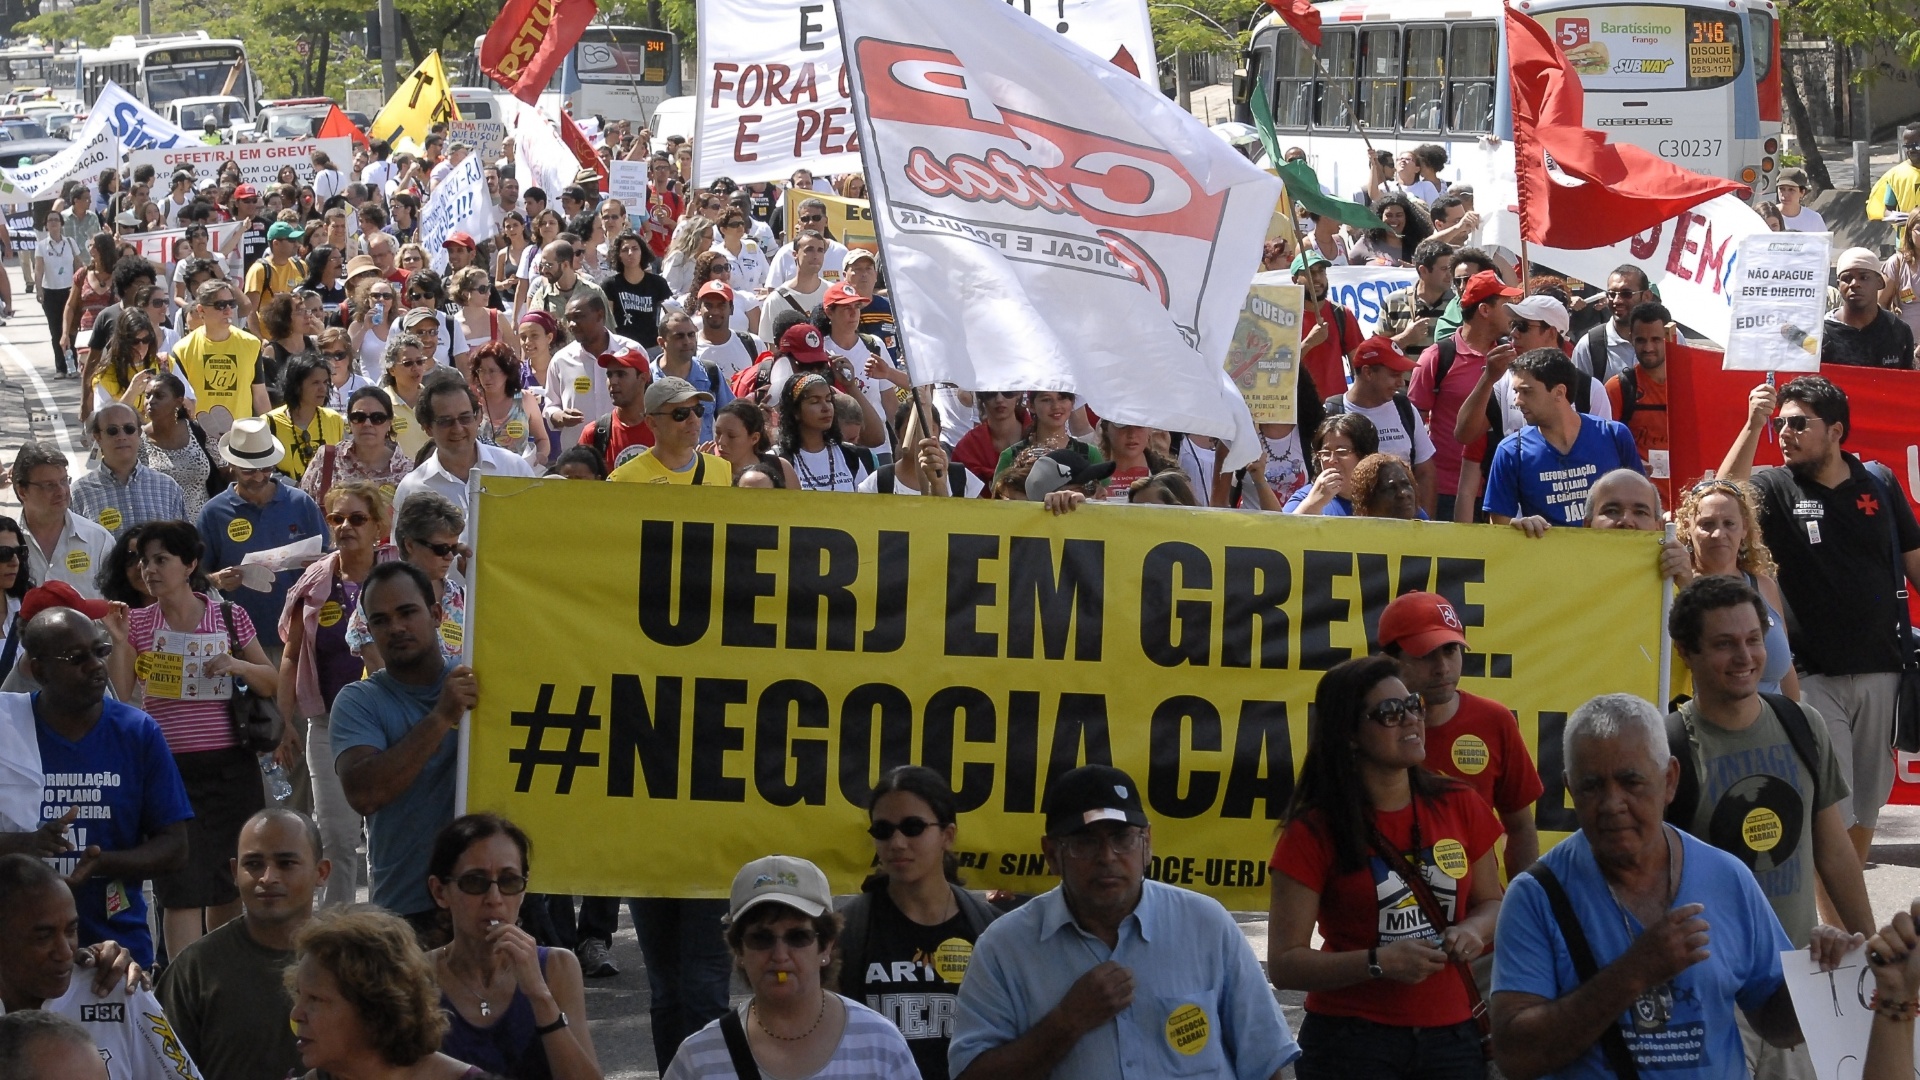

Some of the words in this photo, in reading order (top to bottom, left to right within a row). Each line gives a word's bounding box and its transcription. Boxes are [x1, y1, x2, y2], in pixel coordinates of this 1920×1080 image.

[1601, 22, 1671, 35] Baratíssimo
[1693, 22, 1724, 43] 346
[647, 41, 664, 51] 341
[1632, 36, 1658, 44] Frango
[1691, 46, 1730, 55] DISQUE
[1613, 58, 1674, 74] SUBWAY
[1691, 56, 1732, 64] DENÚNCIA
[711, 62, 820, 108] FORA
[734, 115, 762, 162] E
[164, 149, 235, 165] CEFET/RJ
[240, 149, 261, 161] EM
[266, 144, 317, 158] GREVE
[1658, 139, 1722, 157] C30237
[1747, 268, 1769, 280] NÃO
[1772, 269, 1814, 281] APAGUE
[1742, 286, 1768, 296] ESTE
[1771, 287, 1815, 298] DIREITO!
[1251, 296, 1295, 327] QUERO
[1552, 481, 1563, 492] DO
[1546, 494, 1557, 504] DE
[638, 520, 909, 653] UERJ
[944, 533, 1105, 662] EM
[150, 671, 181, 684] GREVE?
[45, 771, 121, 788] RMULAÇÃO
[57, 789, 102, 803] PLANO
[1745, 821, 1779, 834] #NEGOCIA,
[1749, 831, 1777, 843] CABRAL!
[1145, 856, 1266, 887] DCE-UERJ
[84, 1004, 123, 1021] FISK
[1169, 1016, 1207, 1040] #NEGOCIA,
[1690, 1027, 1704, 1037] do
[1176, 1027, 1207, 1048] CABRAL!
[1627, 1040, 1701, 1051] osicionamento
[1637, 1053, 1700, 1065] aposentados
